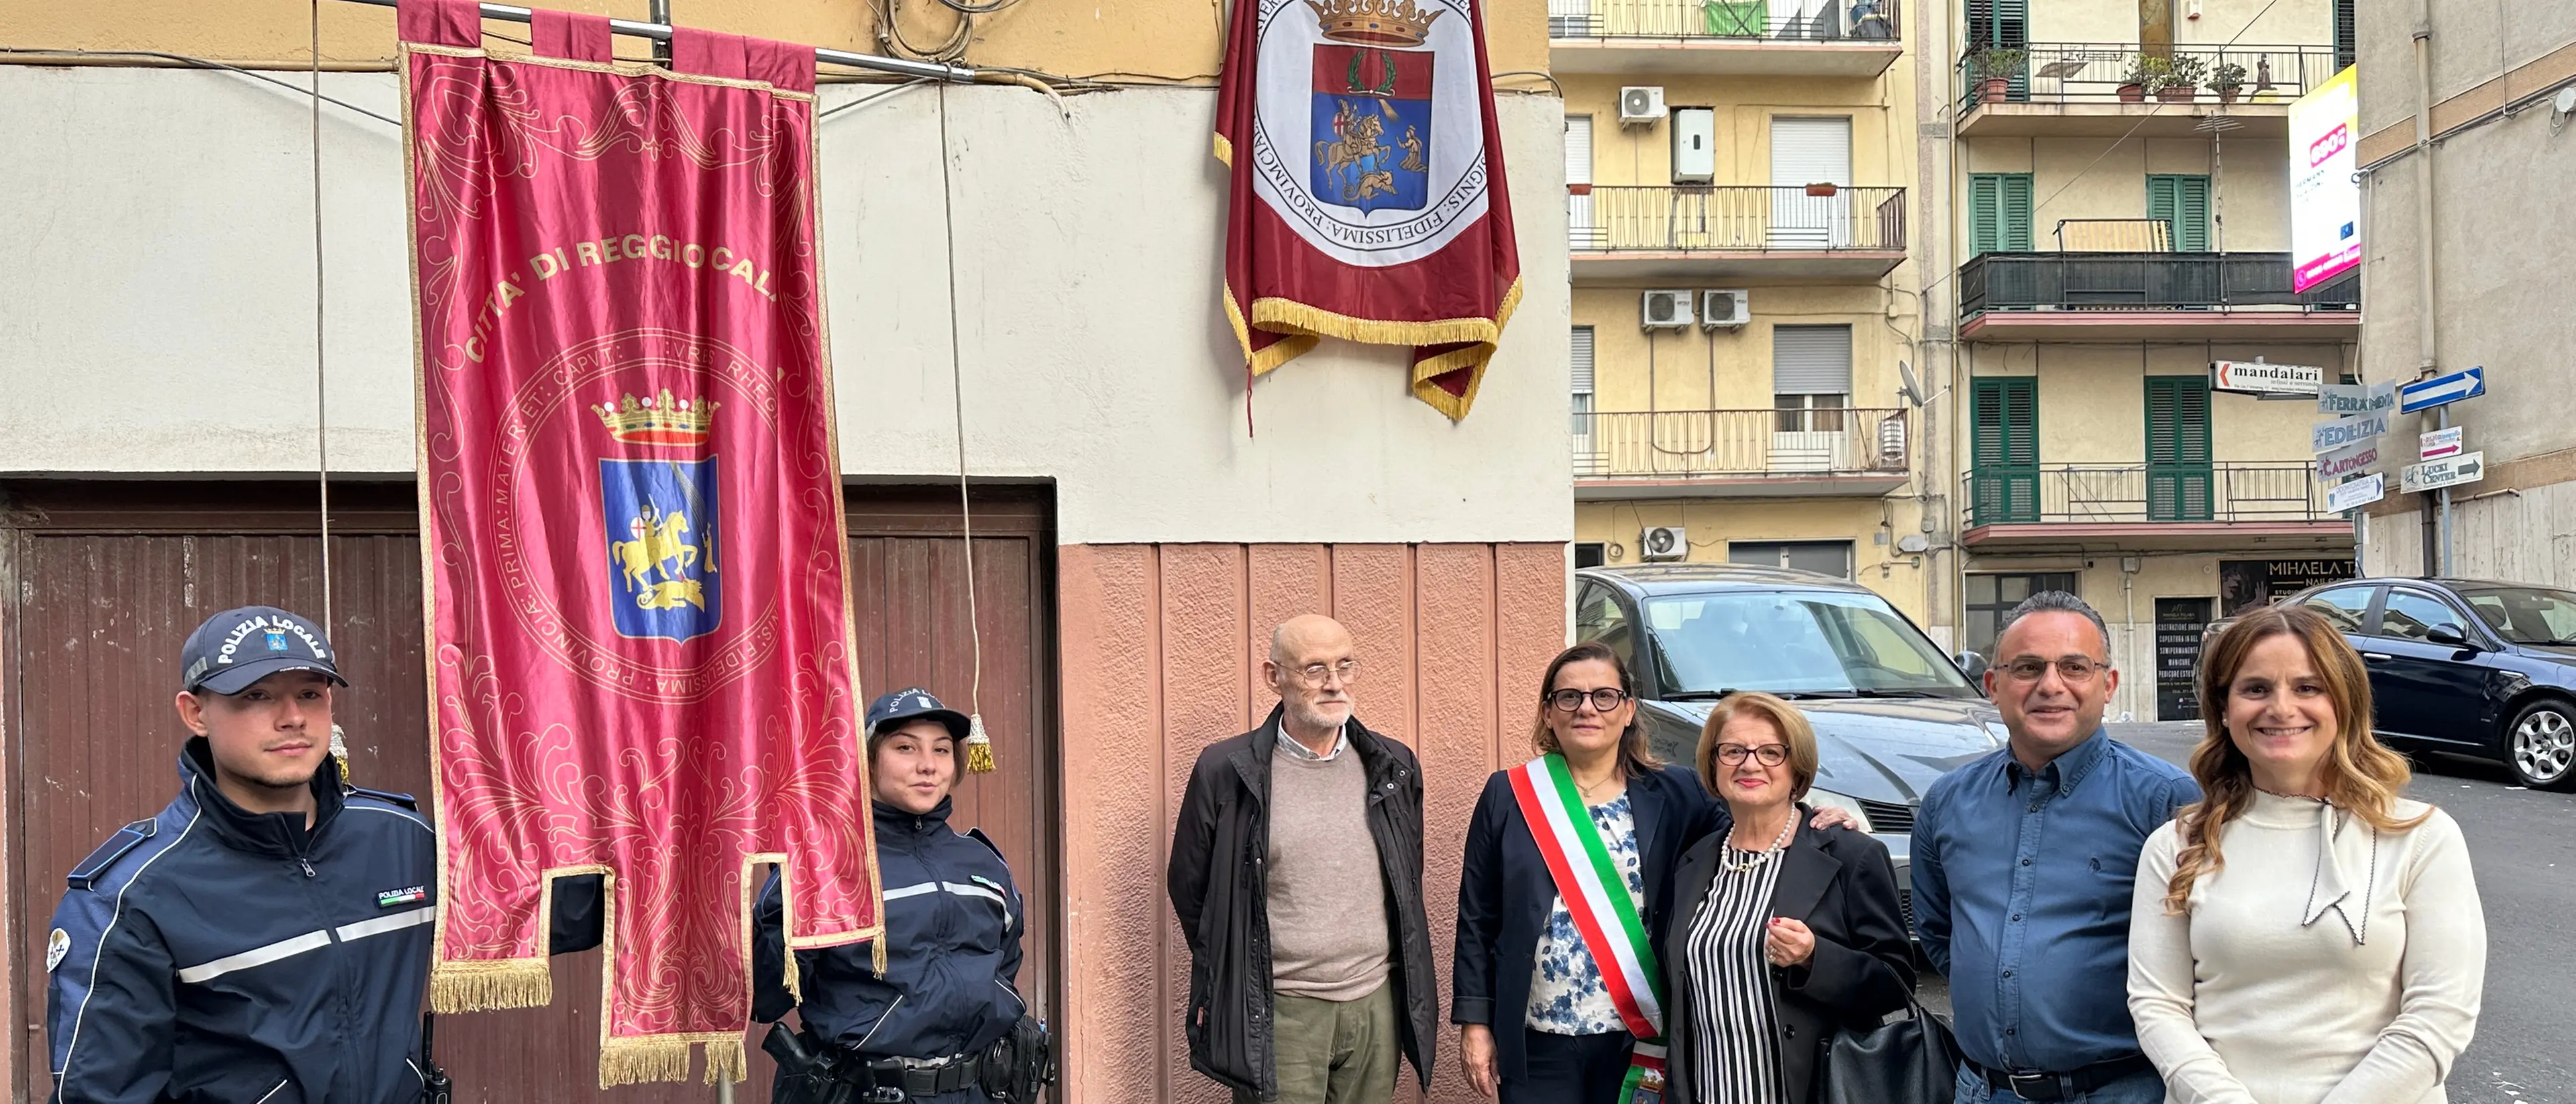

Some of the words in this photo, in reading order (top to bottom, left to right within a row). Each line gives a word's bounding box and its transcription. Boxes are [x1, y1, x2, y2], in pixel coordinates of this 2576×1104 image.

[466, 271, 525, 363] CITTA'
[530, 247, 570, 281] DI
[576, 234, 704, 268] REGGIO
[2235, 367, 2318, 381] mandalari
[2323, 417, 2385, 446] EDILIZIA
[2323, 448, 2377, 476] CARTONGESSO
[2421, 462, 2448, 476] LUCKI
[2423, 471, 2456, 485] CENTER
[2269, 561, 2341, 575] MIHAELA
[217, 615, 269, 664] POLIZIA
[272, 615, 327, 660] LOCALE
[889, 688, 920, 713] POLIZIA
[378, 889, 403, 899] POLIZIA
[404, 886, 424, 895] LOCALE
